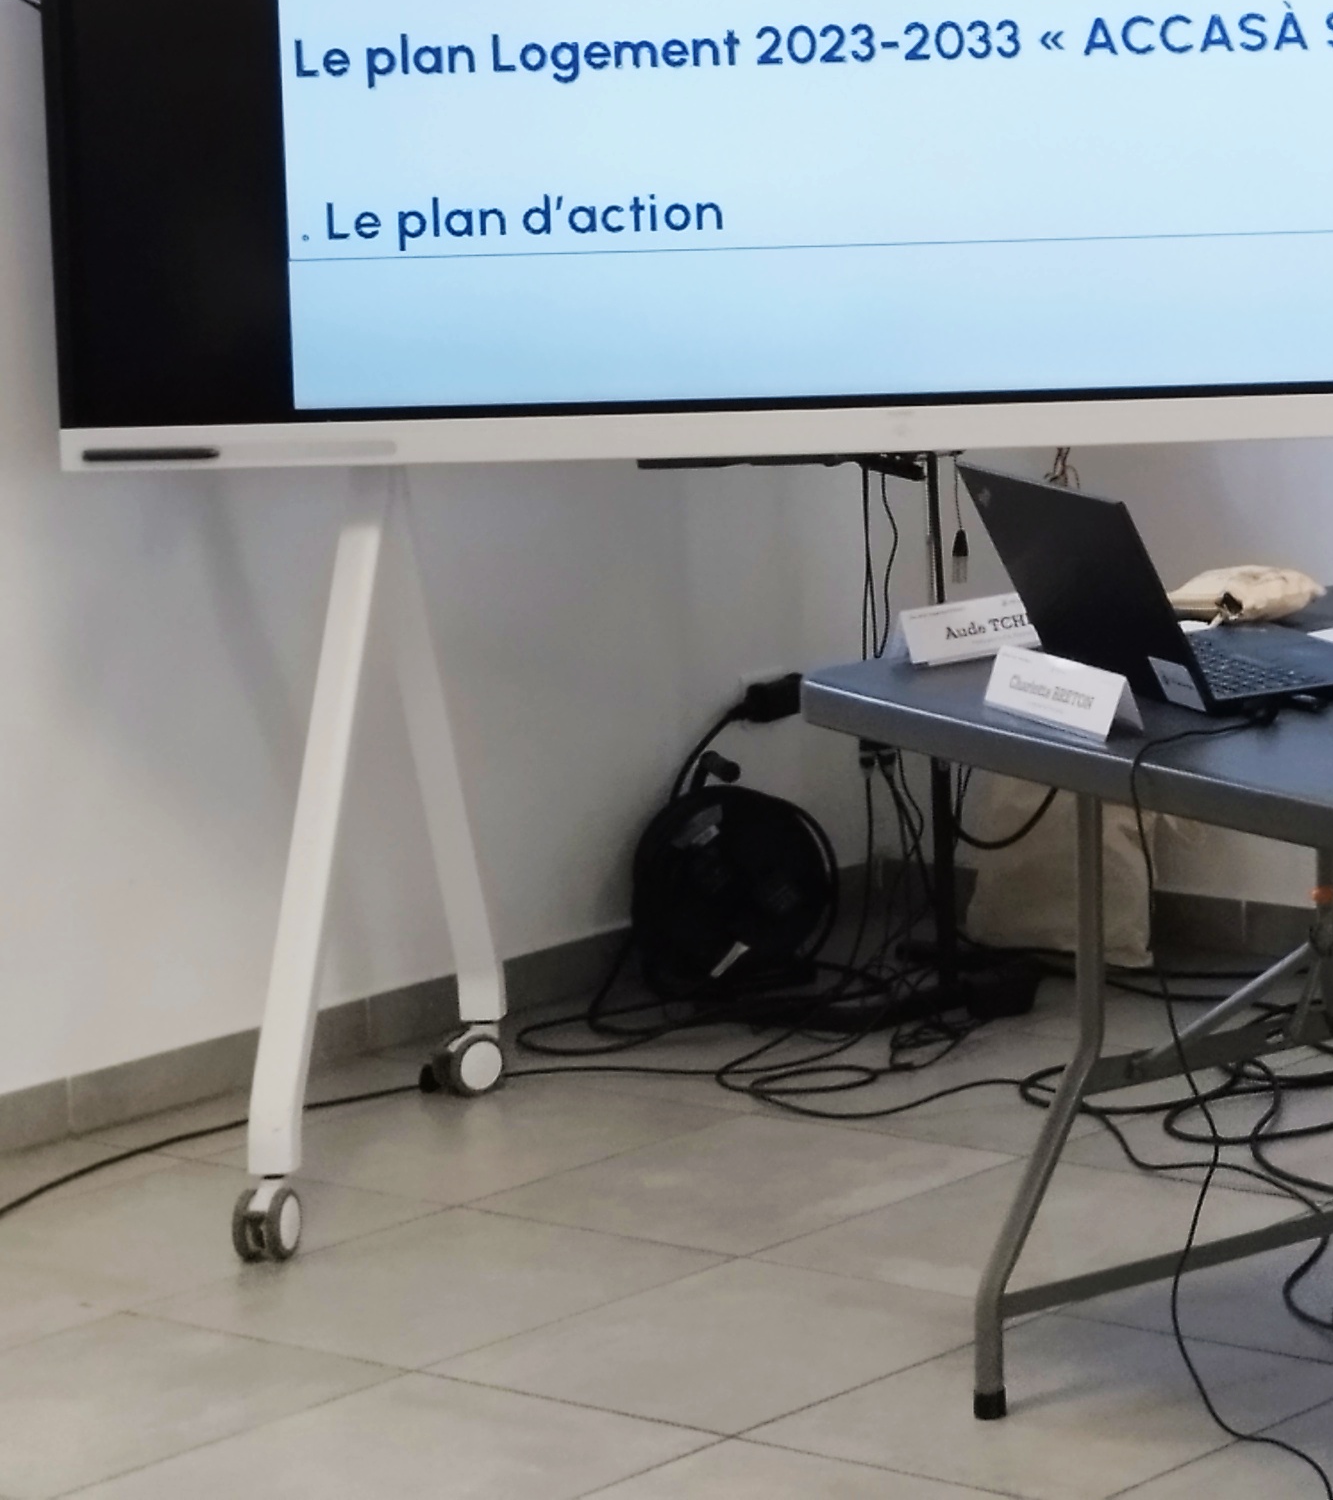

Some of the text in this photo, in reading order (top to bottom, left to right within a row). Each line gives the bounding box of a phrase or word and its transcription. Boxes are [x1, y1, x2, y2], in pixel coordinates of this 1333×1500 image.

[294, 39, 351, 78] Le
[366, 33, 476, 90] plan
[491, 29, 741, 85] Logement
[755, 19, 1021, 66] 2023-2033
[1083, 1, 1309, 57] ACCASÀ
[326, 194, 724, 252] Le plan d'action
